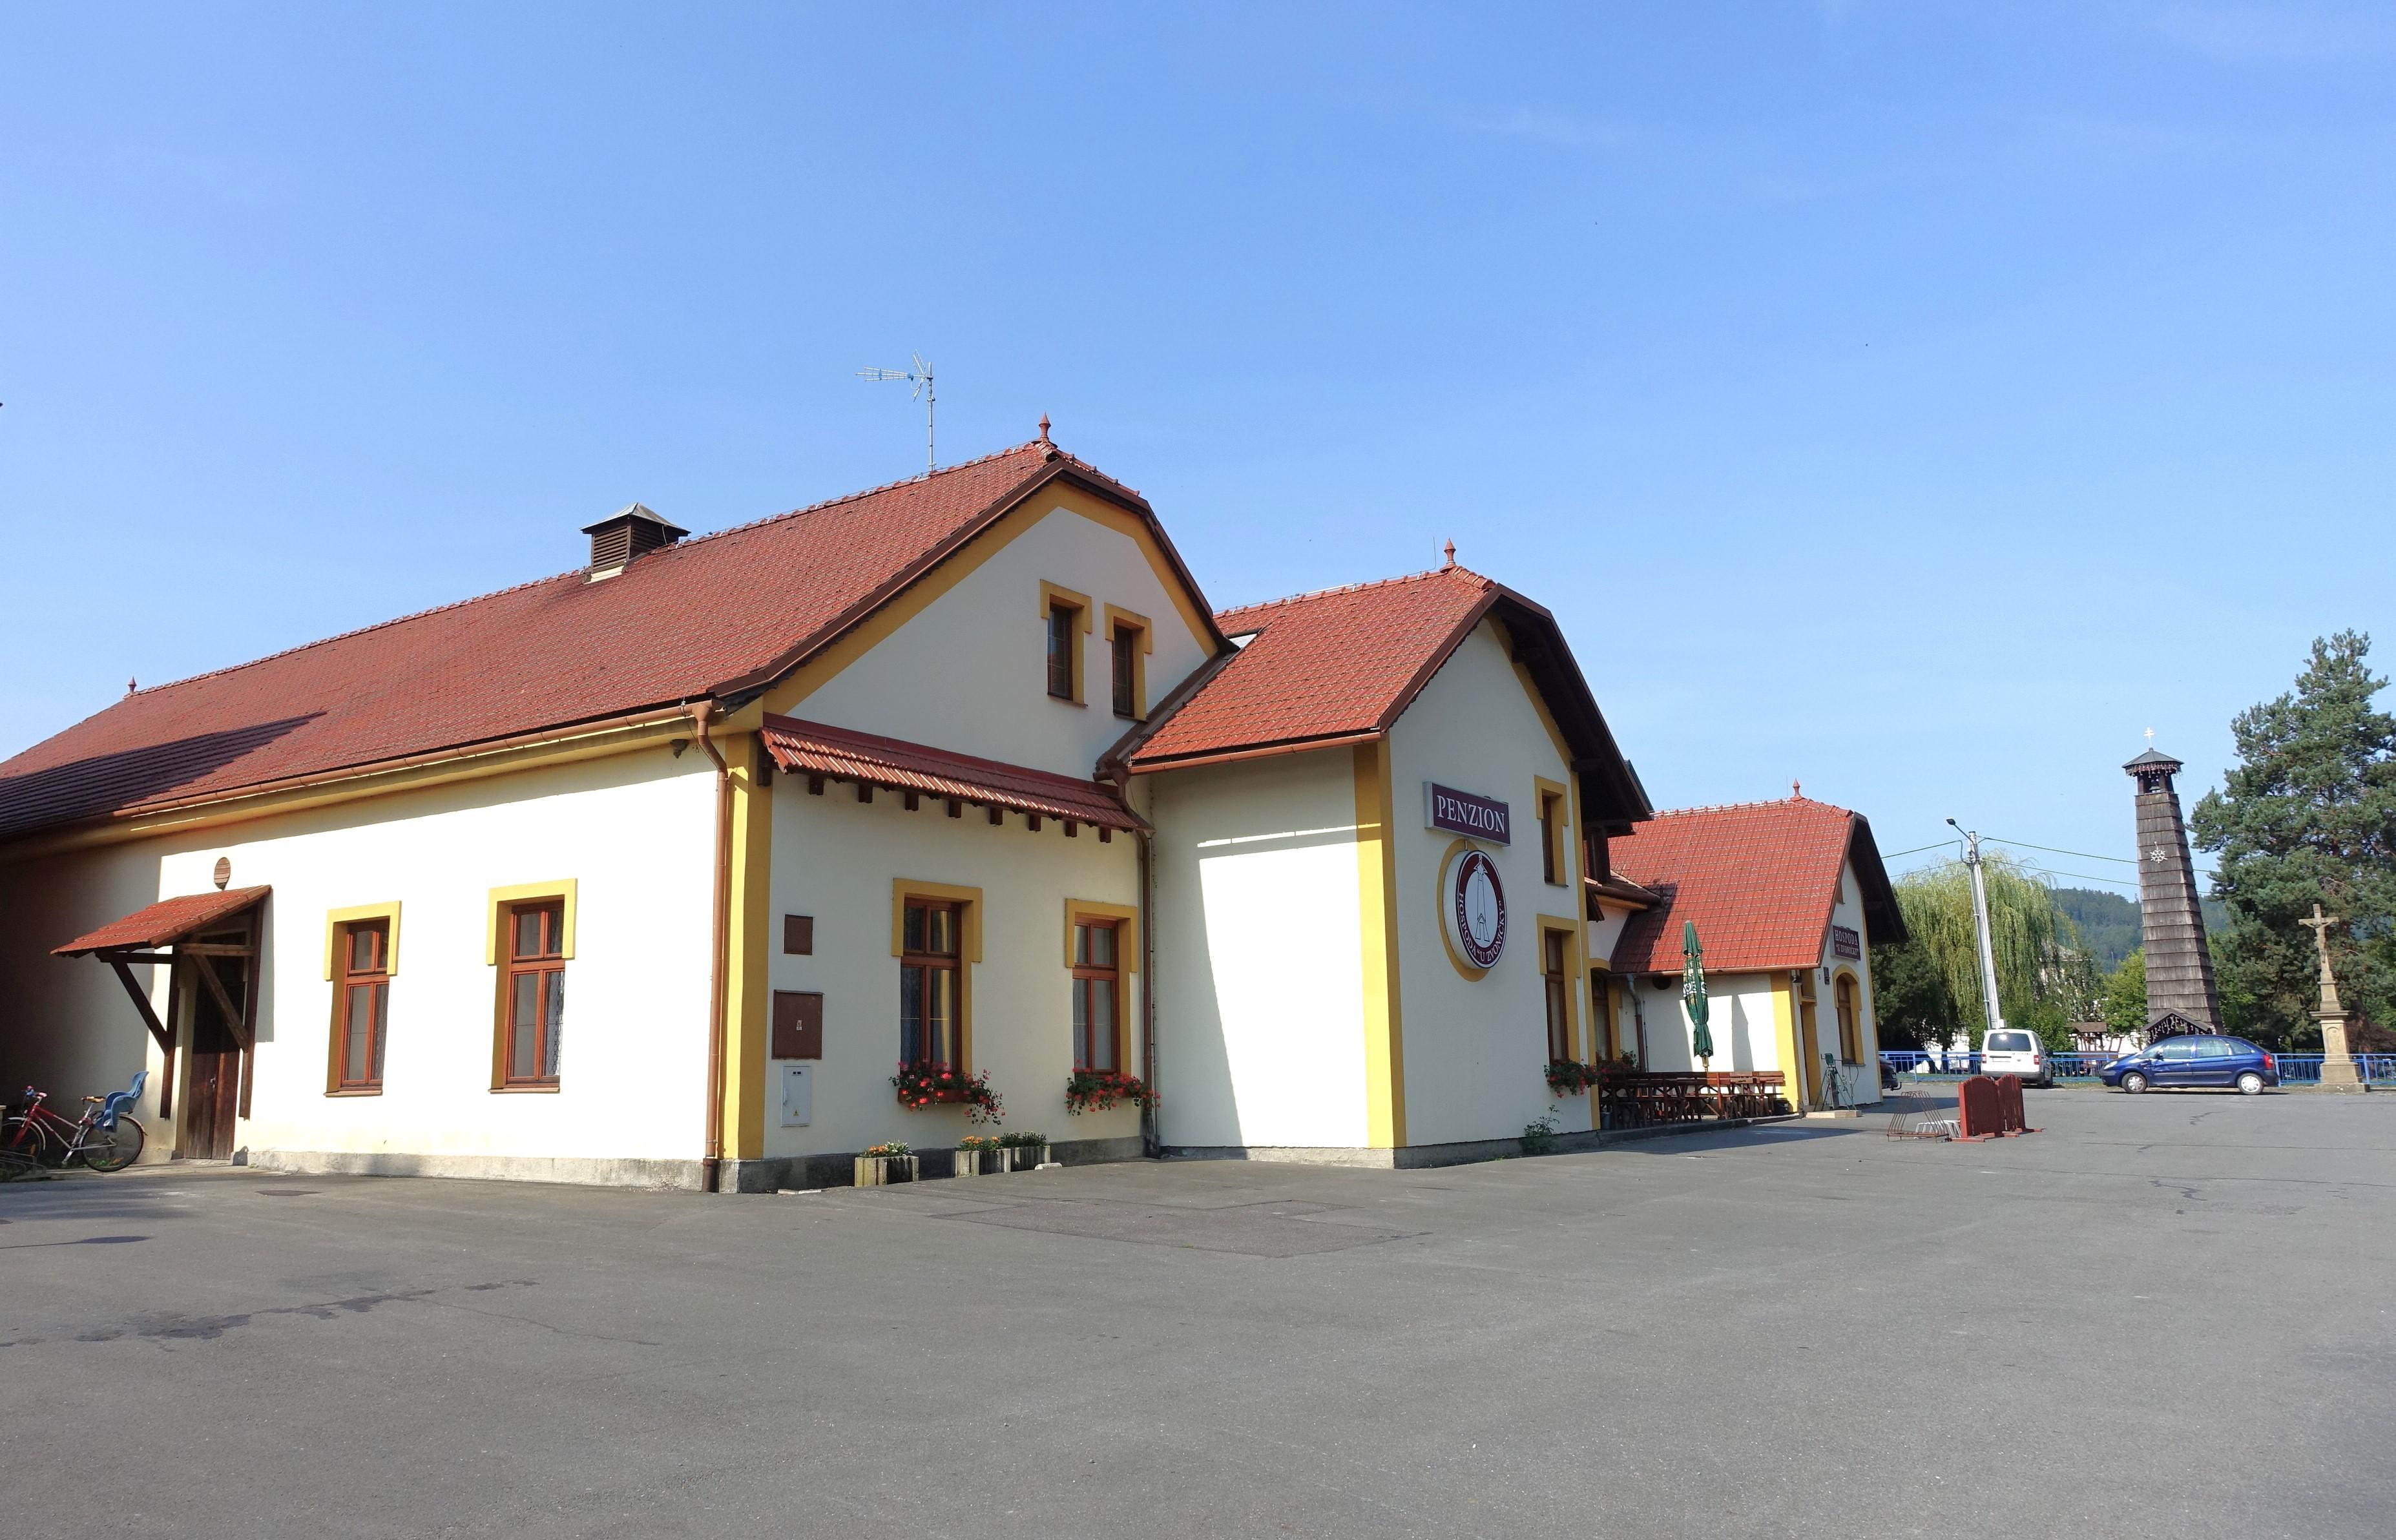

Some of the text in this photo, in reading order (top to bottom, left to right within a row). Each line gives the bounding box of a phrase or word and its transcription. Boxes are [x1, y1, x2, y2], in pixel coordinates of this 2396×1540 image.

[1436, 795, 1505, 834] PENZION
[1459, 892, 1477, 957] HOSPODA
[1835, 930, 1859, 946] HOSPODA
